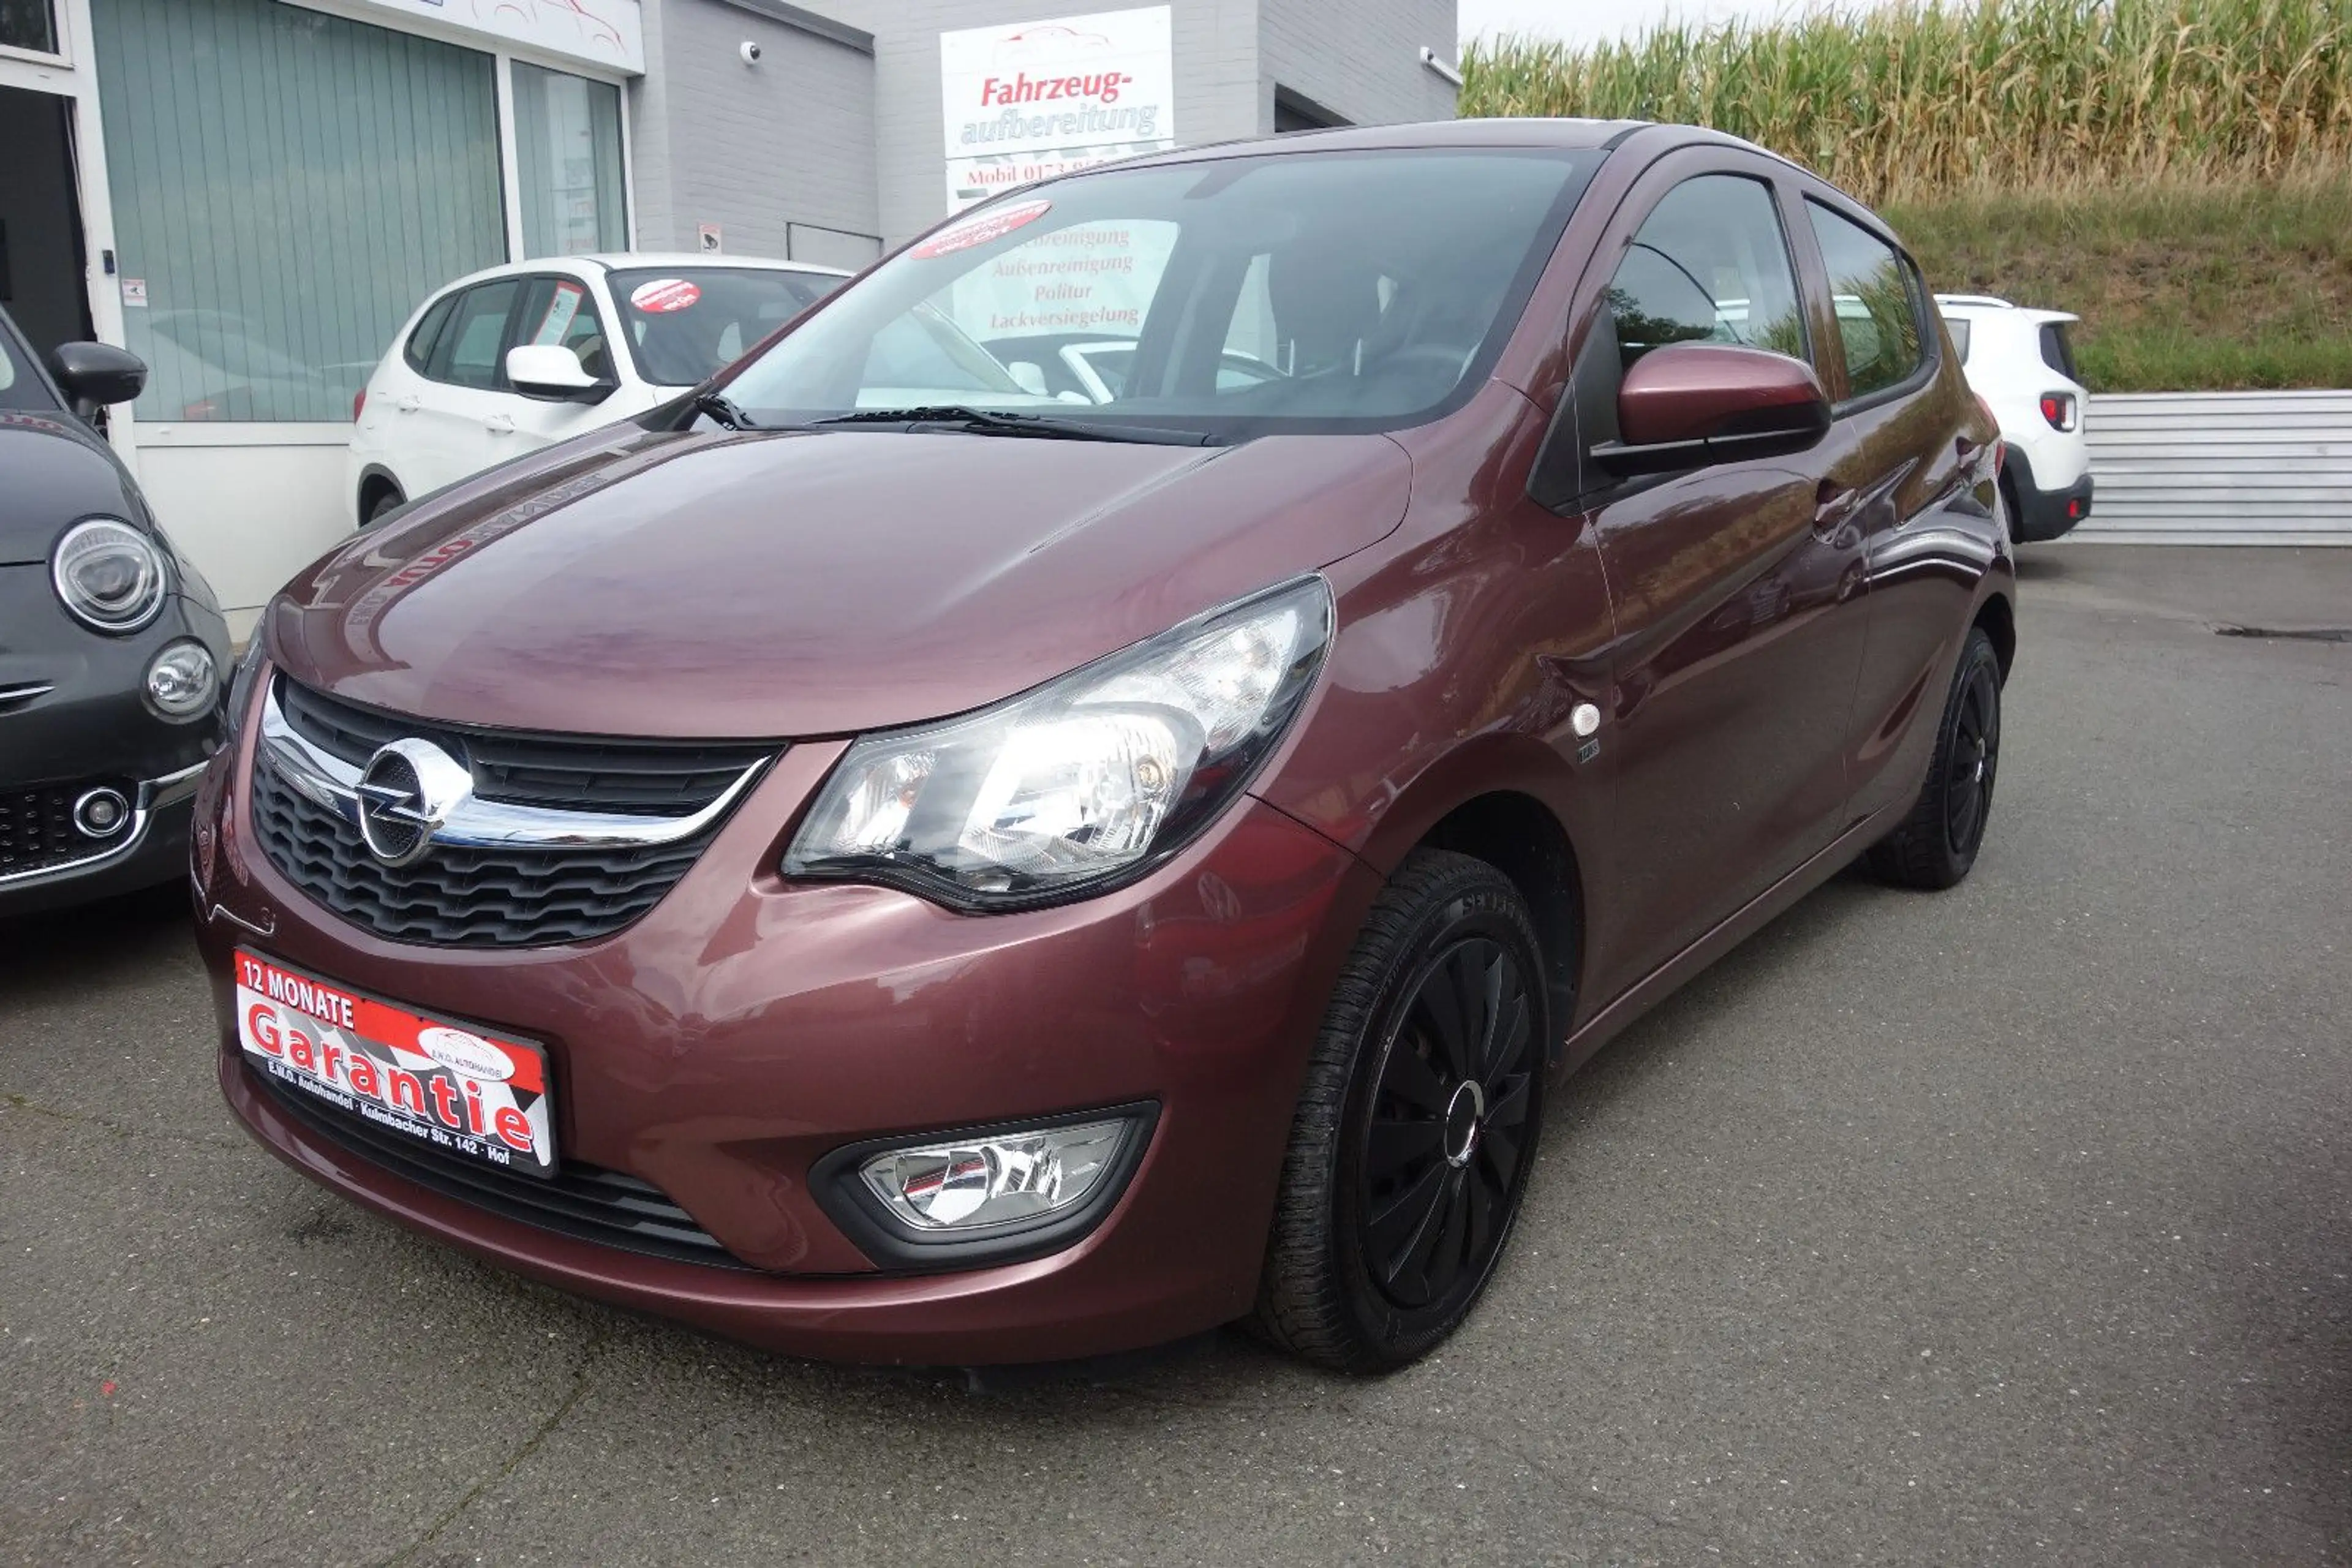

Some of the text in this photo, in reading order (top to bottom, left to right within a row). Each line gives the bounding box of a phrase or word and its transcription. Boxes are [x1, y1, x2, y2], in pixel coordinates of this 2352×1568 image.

[982, 72, 1133, 106] Fahrzeug-
[962, 103, 1158, 145] aufbereitung
[967, 163, 1017, 184] Mobil
[992, 254, 1133, 277] Außenreinigung
[1033, 284, 1093, 301] Politur
[990, 307, 1139, 330] Lackversiegelung
[244, 960, 354, 1029] 12 MONATE
[247, 1003, 534, 1153] Garantie
[268, 1062, 511, 1165] E.W.O. Autohandel Kulmbacher Str. 142 Hof
